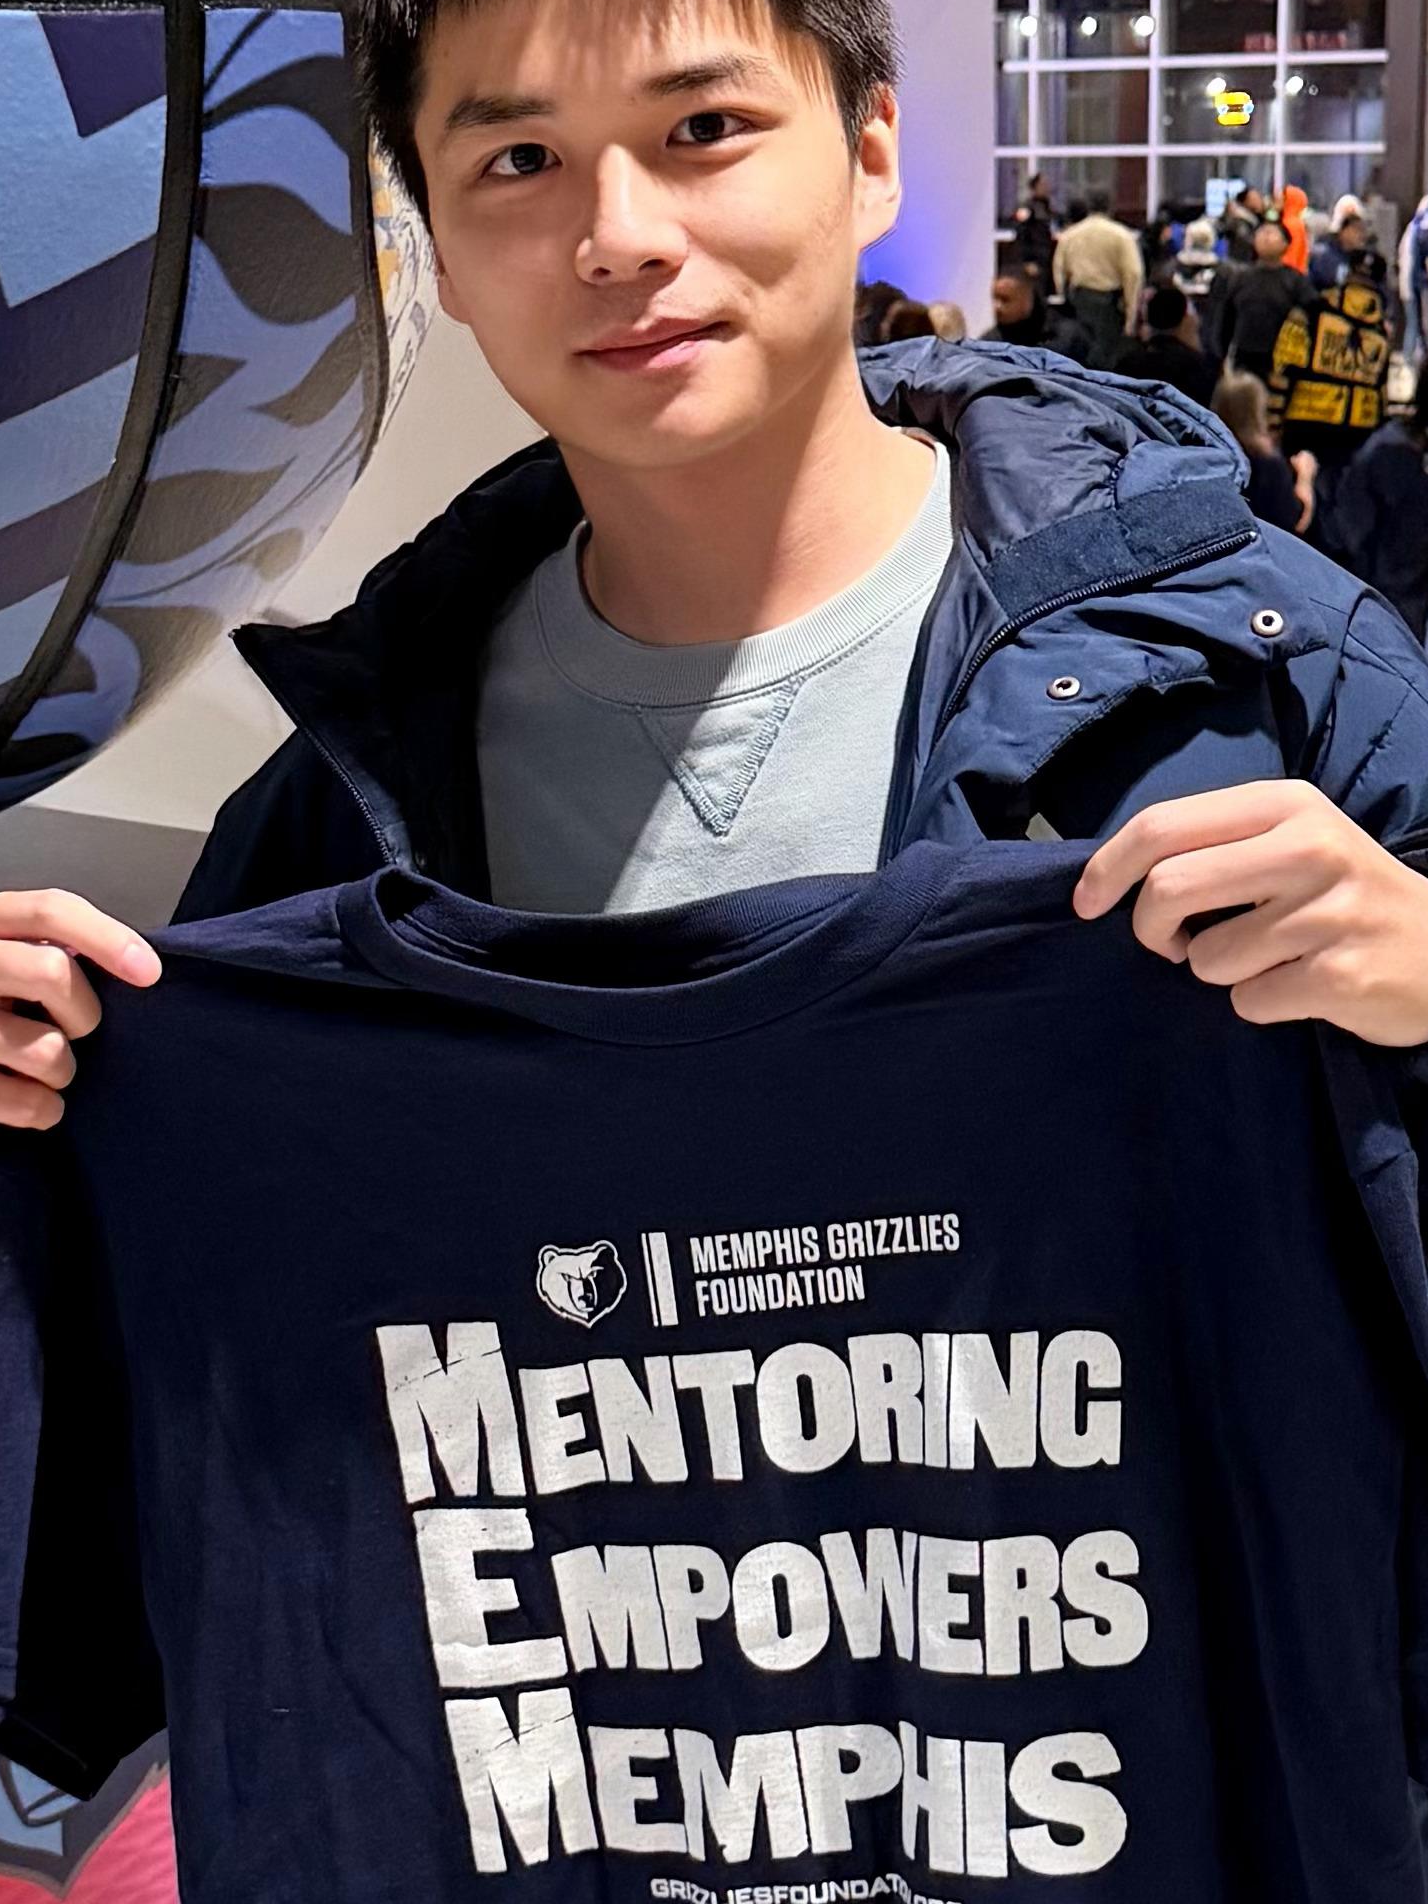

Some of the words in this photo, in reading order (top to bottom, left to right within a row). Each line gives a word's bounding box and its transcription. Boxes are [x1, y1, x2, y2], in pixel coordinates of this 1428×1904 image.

[690, 1226, 820, 1274] MEMPHIS
[826, 1213, 961, 1260] GRIZZLIES
[695, 1265, 866, 1317] FOUNDATION
[375, 1321, 1123, 1504] MENTORING
[412, 1507, 1149, 1688] EMPOWERS
[444, 1686, 1127, 1878] MEMPHIS
